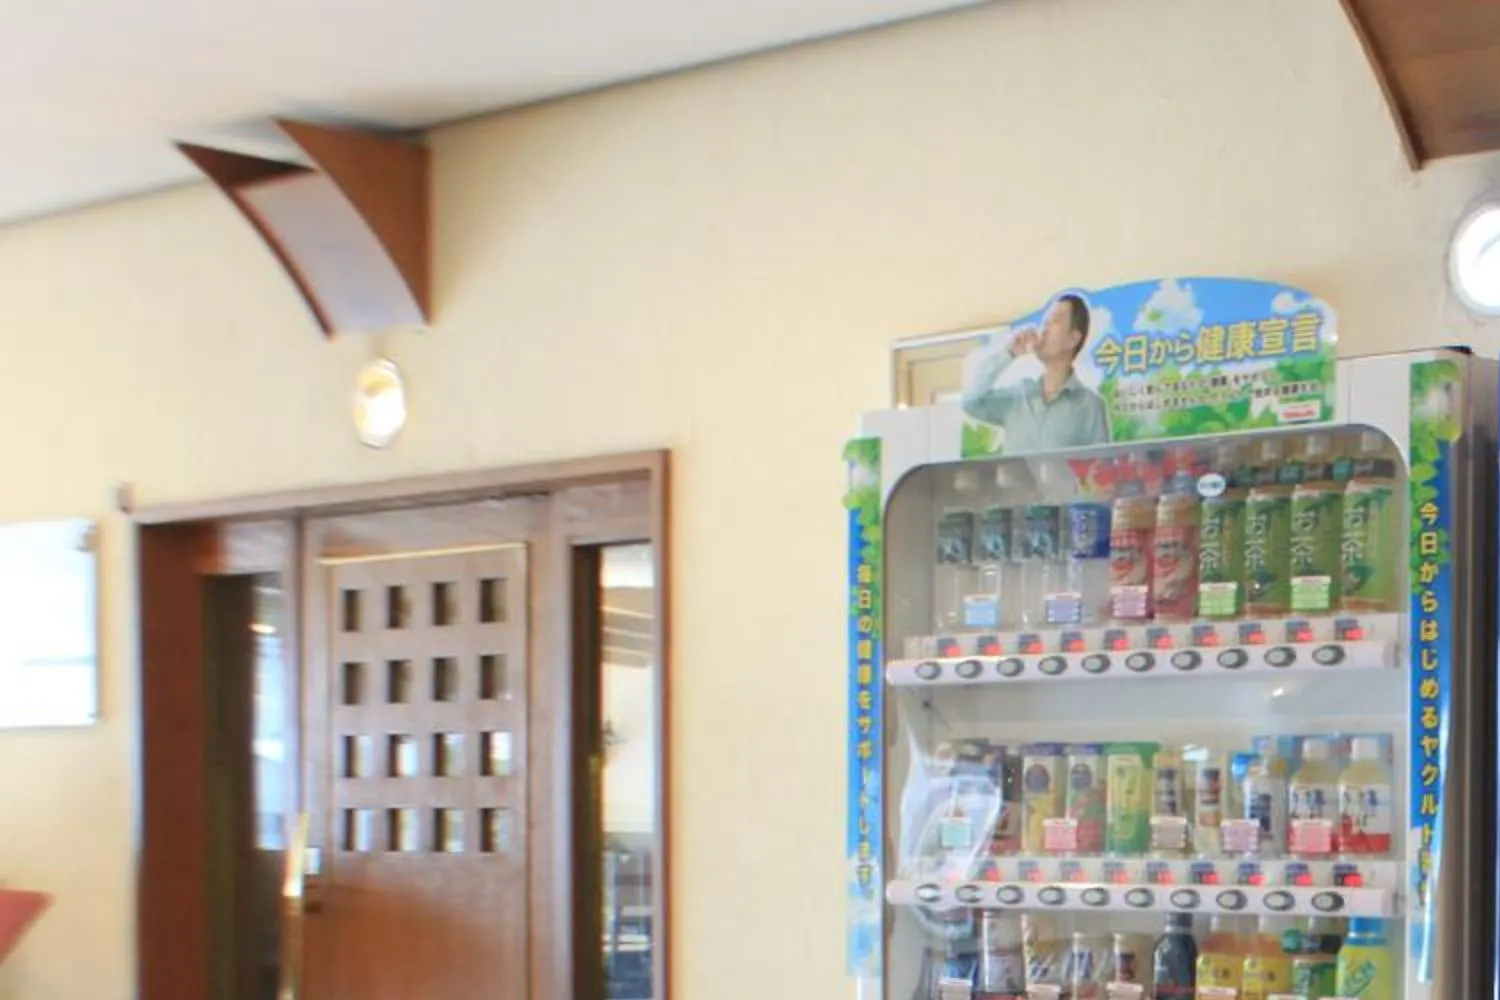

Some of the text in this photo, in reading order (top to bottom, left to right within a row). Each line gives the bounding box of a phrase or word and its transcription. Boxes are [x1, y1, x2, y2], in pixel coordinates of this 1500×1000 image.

[1094, 312, 1324, 373] 今日から健康宣言
